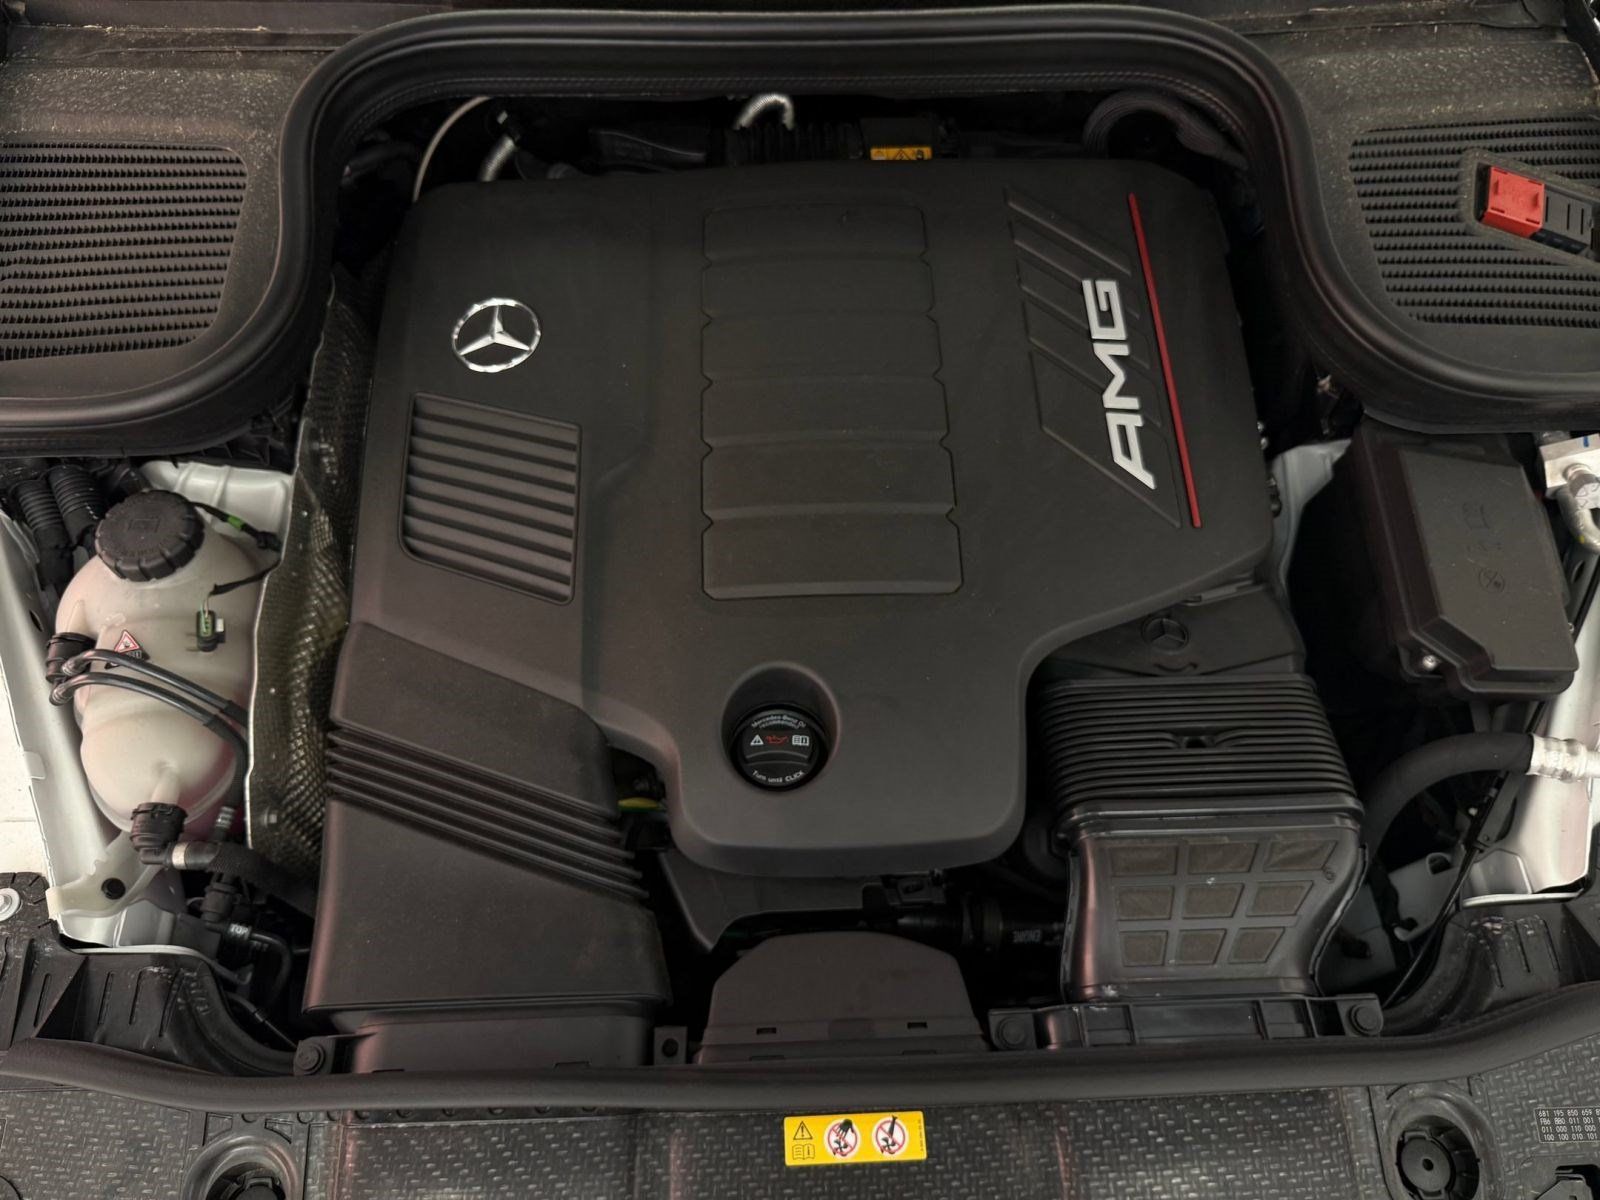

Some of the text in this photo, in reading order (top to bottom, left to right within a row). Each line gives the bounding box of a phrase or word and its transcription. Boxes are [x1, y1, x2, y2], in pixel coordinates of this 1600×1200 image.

[1081, 279, 1157, 490] AMG
[752, 770, 766, 781] Turn
[785, 770, 805, 781] CLICK
[1543, 1133, 1554, 1141] 100
[1587, 1132, 1597, 1140] 101
